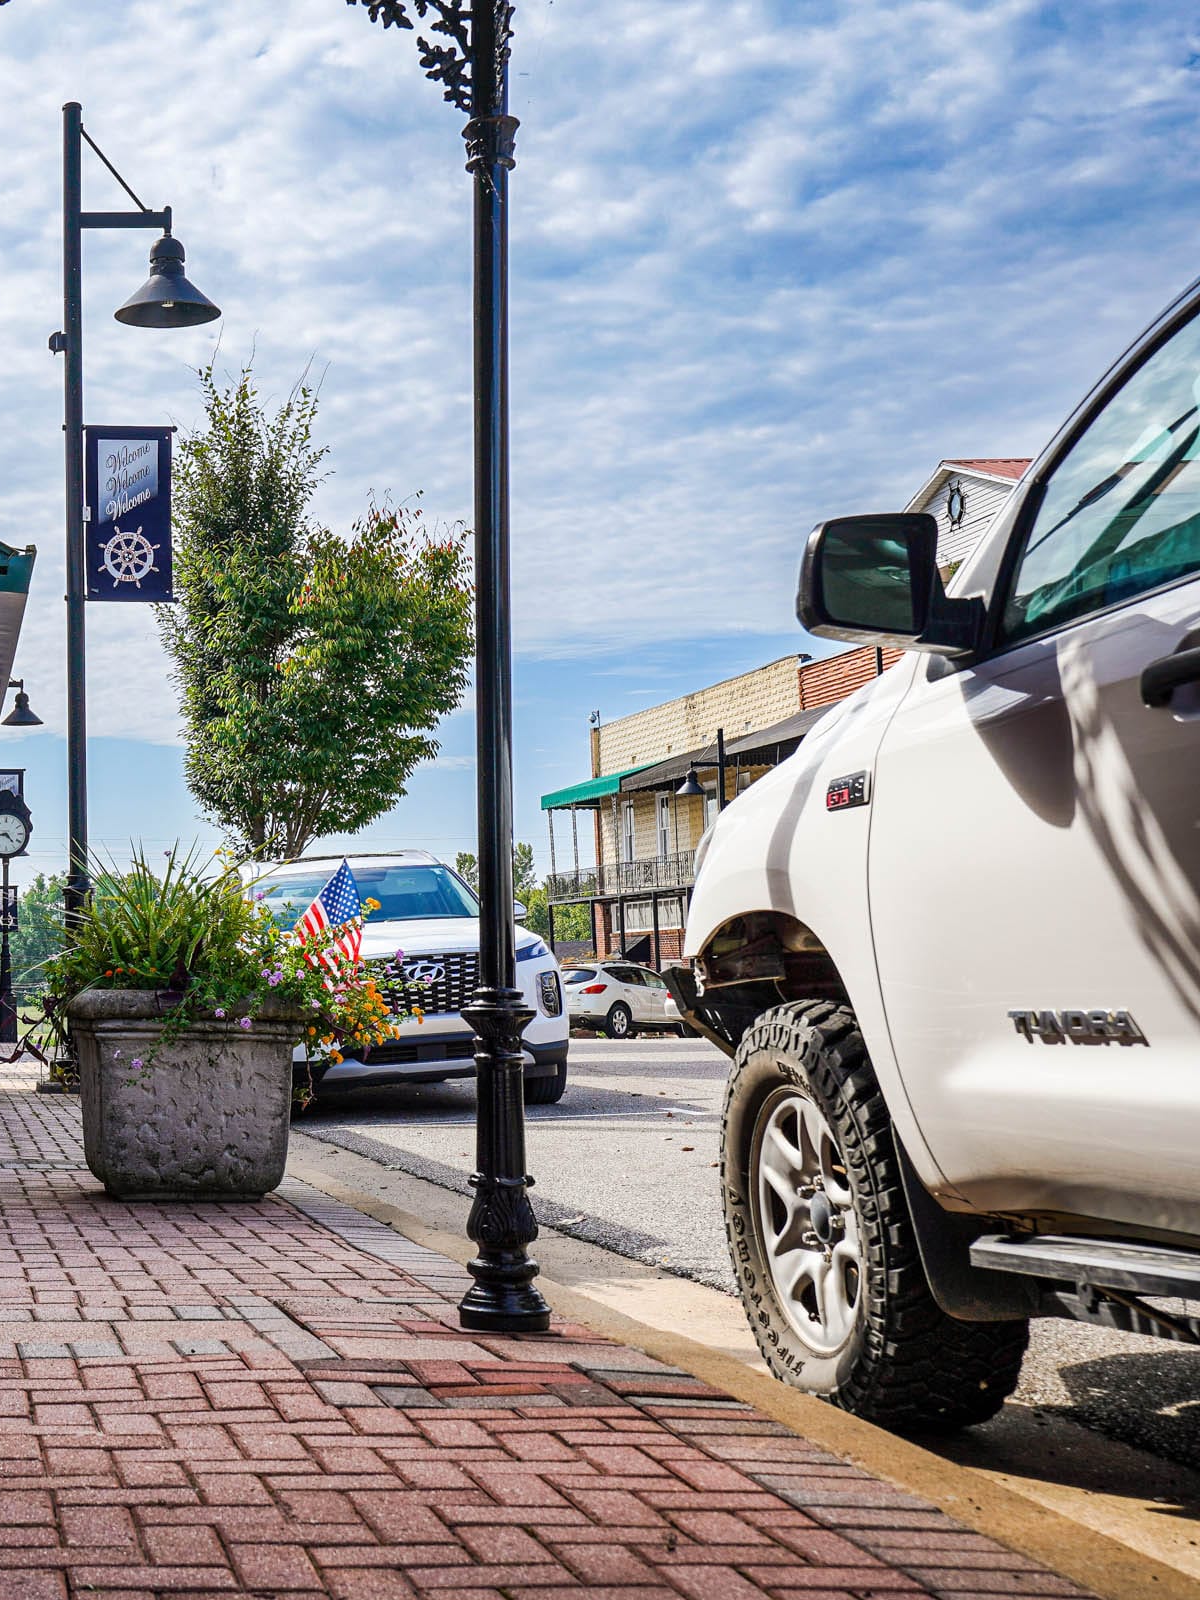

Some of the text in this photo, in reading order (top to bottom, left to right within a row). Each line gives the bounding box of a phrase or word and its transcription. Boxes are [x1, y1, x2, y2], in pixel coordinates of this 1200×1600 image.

[105, 442, 151, 474] Welcome
[105, 464, 151, 497] Welcome
[105, 487, 151, 521] Welcome
[1008, 1009, 1148, 1045] TUNDRA
